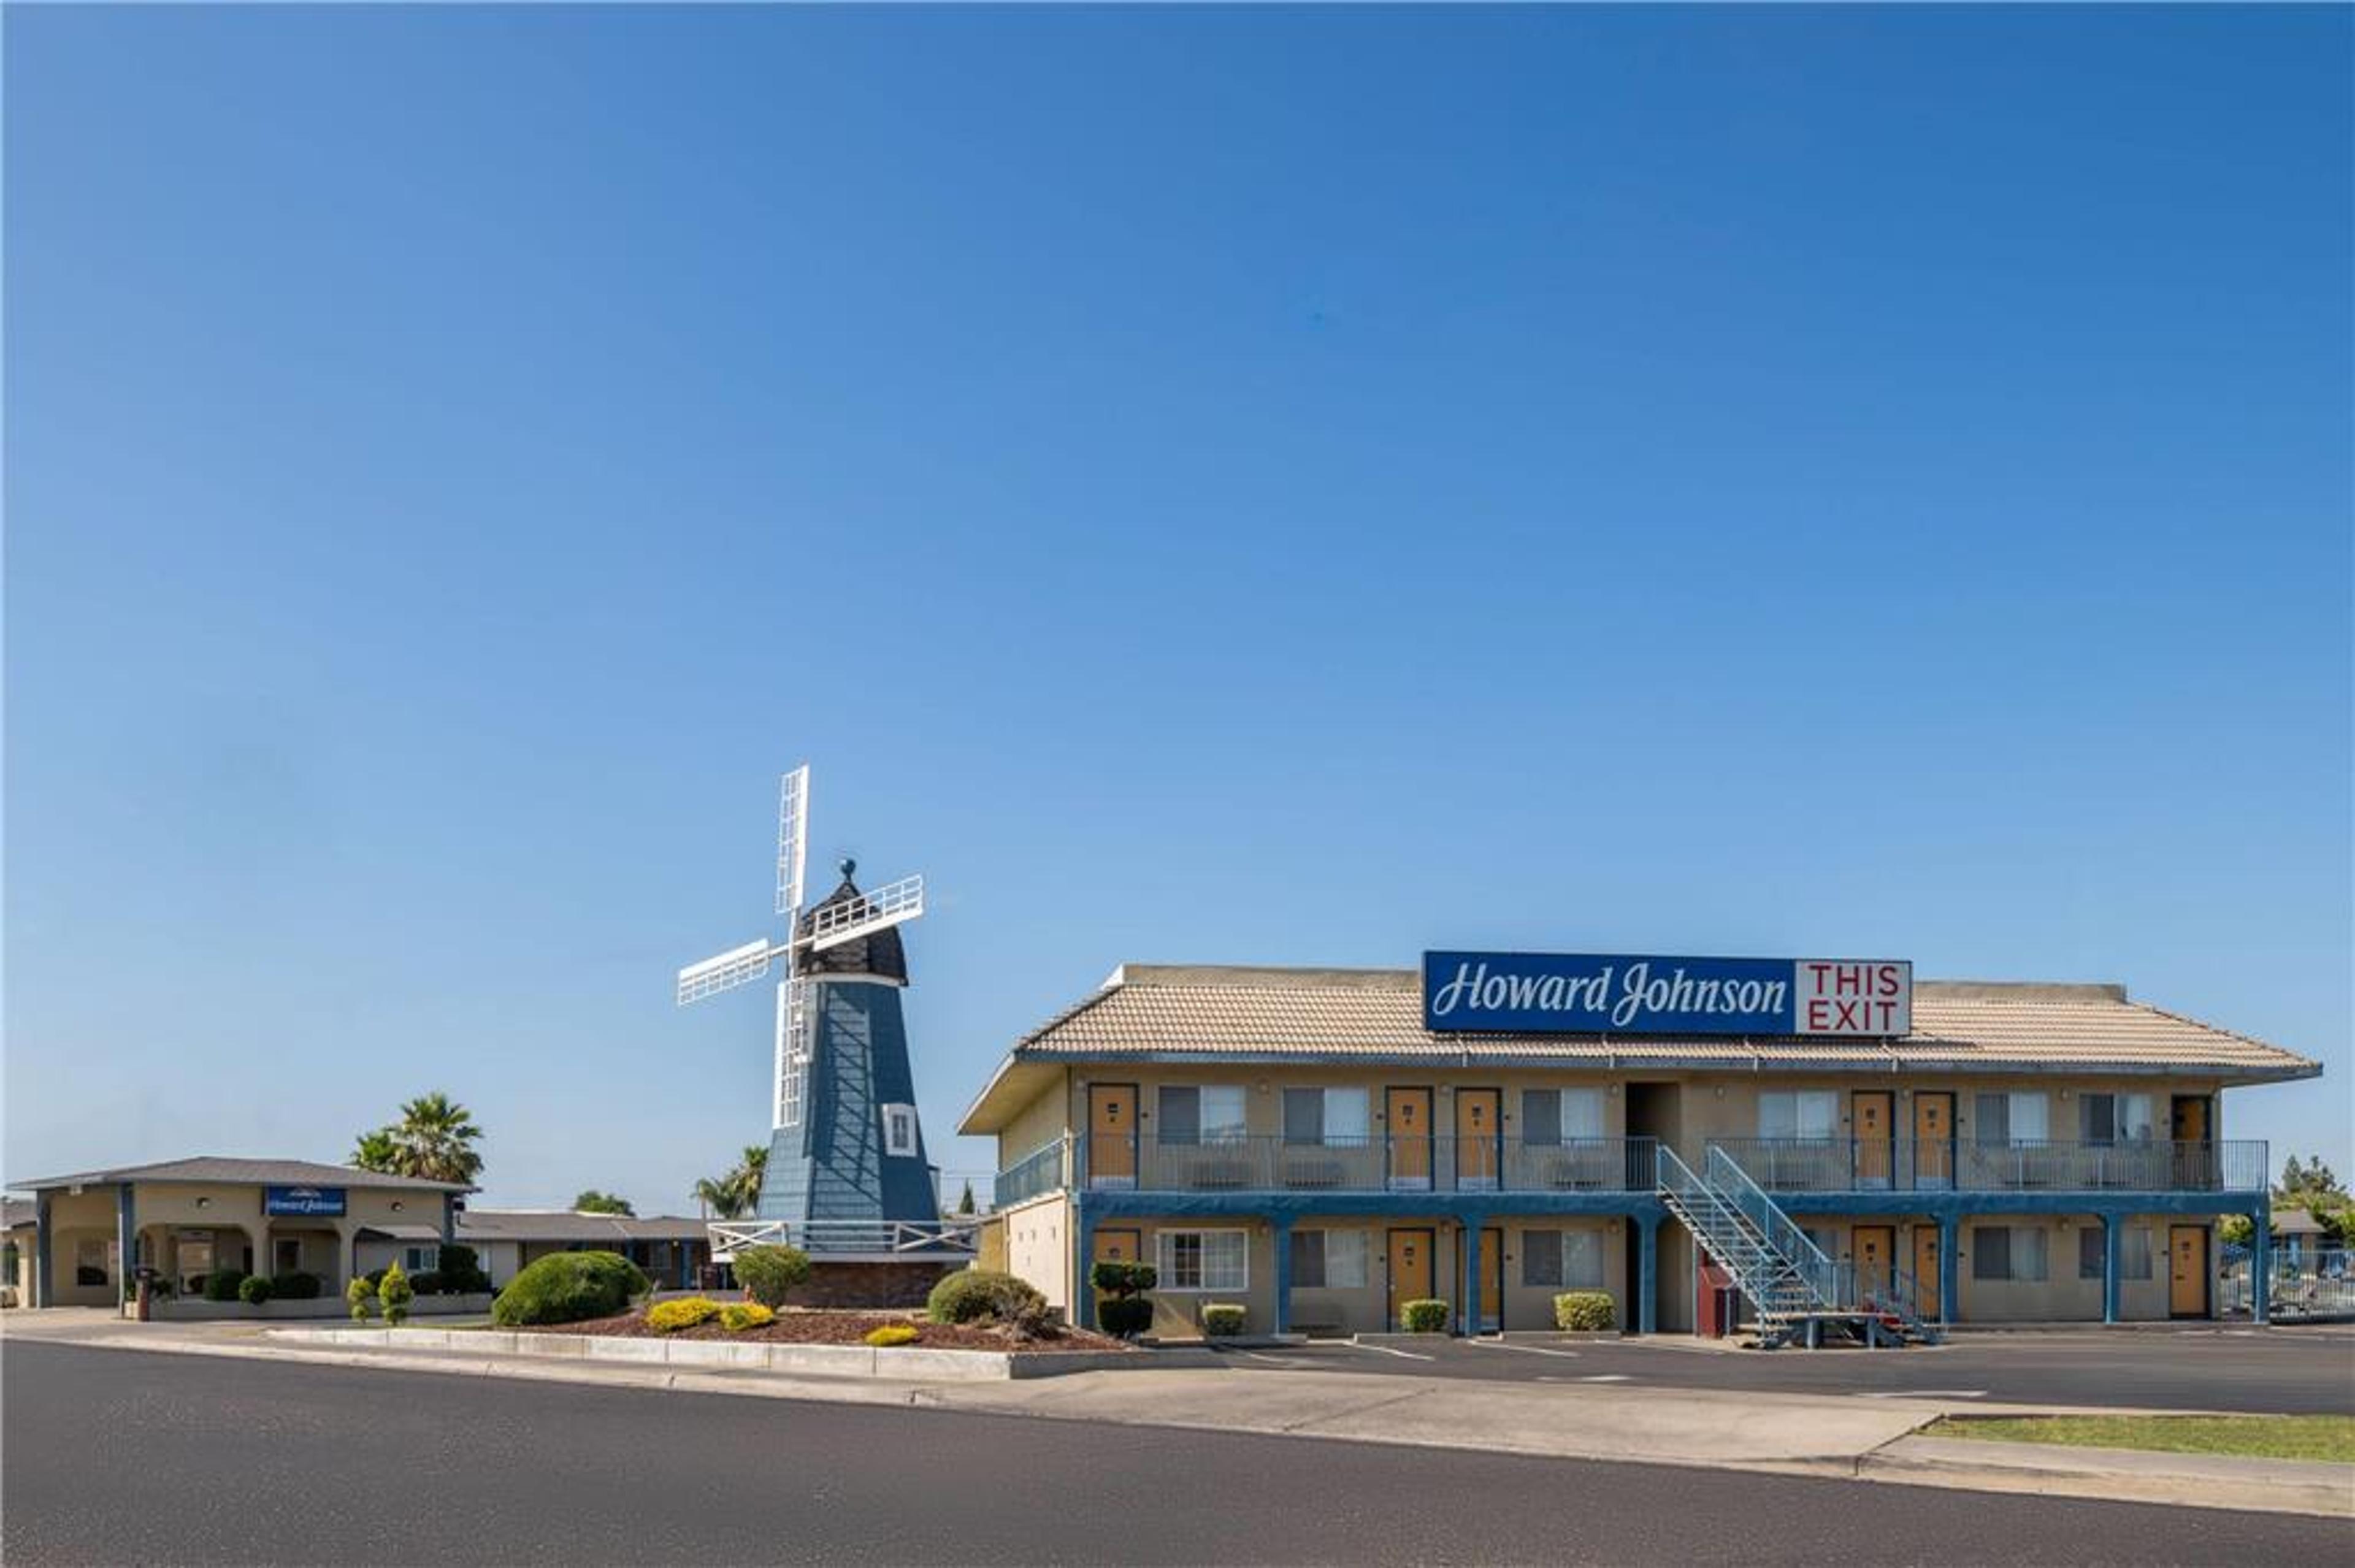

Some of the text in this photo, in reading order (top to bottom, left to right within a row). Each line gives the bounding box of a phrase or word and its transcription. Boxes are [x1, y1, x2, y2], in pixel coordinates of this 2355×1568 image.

[1433, 963, 1786, 1027] Howard Johnson
[1809, 965, 1899, 995] THIS
[1809, 1000, 1897, 1031] EXIT
